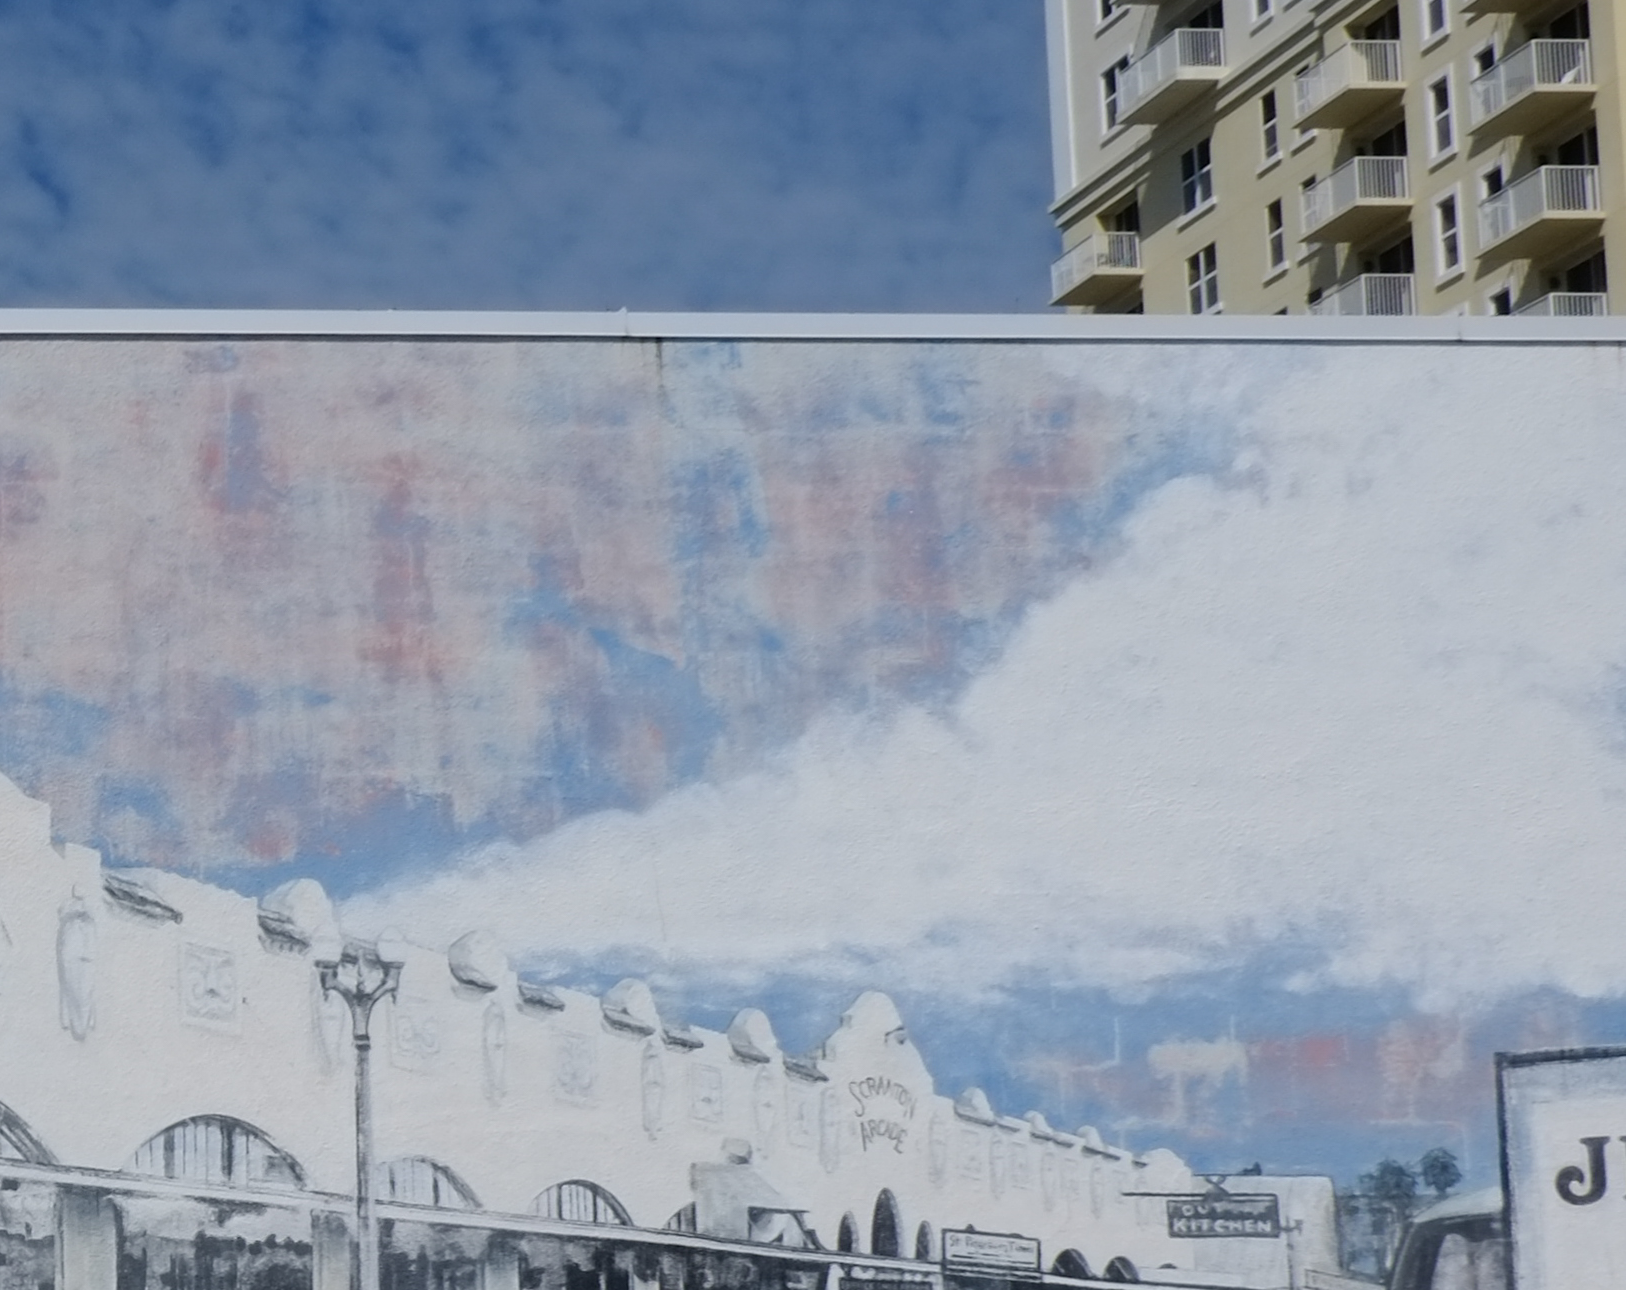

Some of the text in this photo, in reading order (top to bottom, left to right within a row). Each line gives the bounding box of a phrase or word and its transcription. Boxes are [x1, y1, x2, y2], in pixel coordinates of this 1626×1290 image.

[848, 1076, 918, 1120] SCRANTON
[859, 1118, 909, 1154] ARCADE
[1172, 1218, 1272, 1233] KITCHEN
